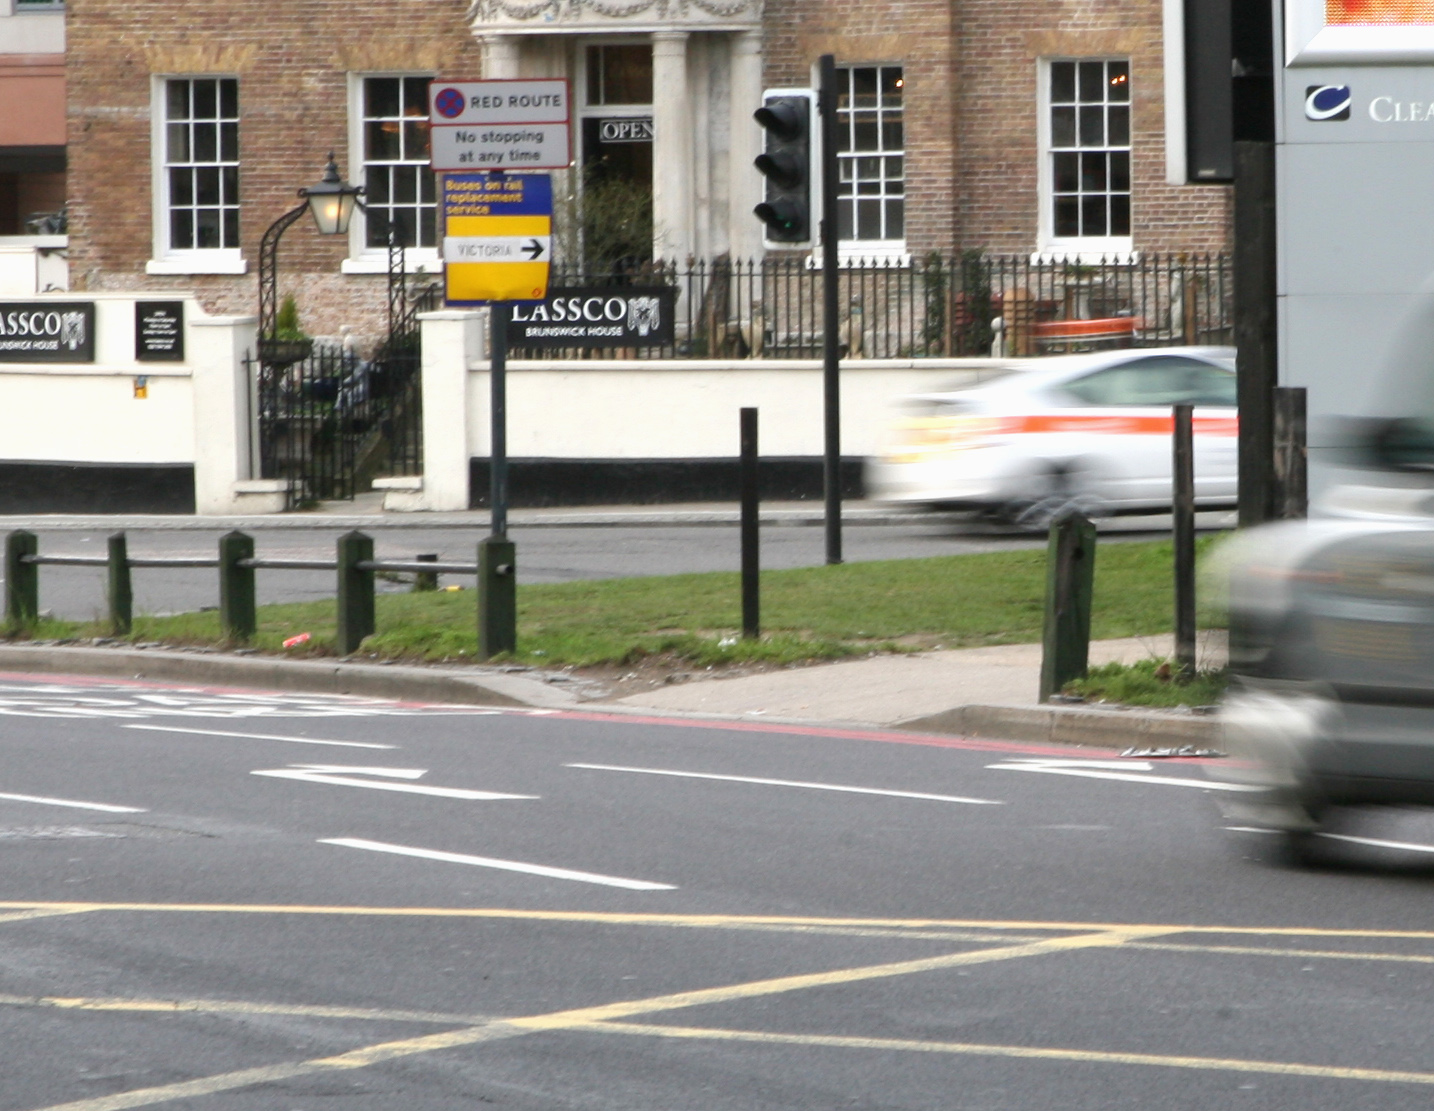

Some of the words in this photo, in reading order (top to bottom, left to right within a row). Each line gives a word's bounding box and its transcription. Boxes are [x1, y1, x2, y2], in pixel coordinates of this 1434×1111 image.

[470, 96, 503, 108] RED
[508, 94, 561, 108] ROUTE
[456, 131, 476, 143] No
[481, 130, 544, 144] stopping
[603, 122, 653, 139] OPEN
[459, 150, 474, 162] at
[479, 152, 504, 164] any
[509, 149, 541, 161] time
[445, 180, 482, 191] Buses
[484, 181, 502, 191] on
[503, 179, 523, 191] rail
[445, 192, 523, 204] replacement
[445, 205, 491, 215] service
[458, 244, 512, 257] VICTORIA
[511, 297, 627, 321] LASSCO
[525, 326, 586, 337] BRUNSWICK
[587, 326, 624, 337] HOUSE
